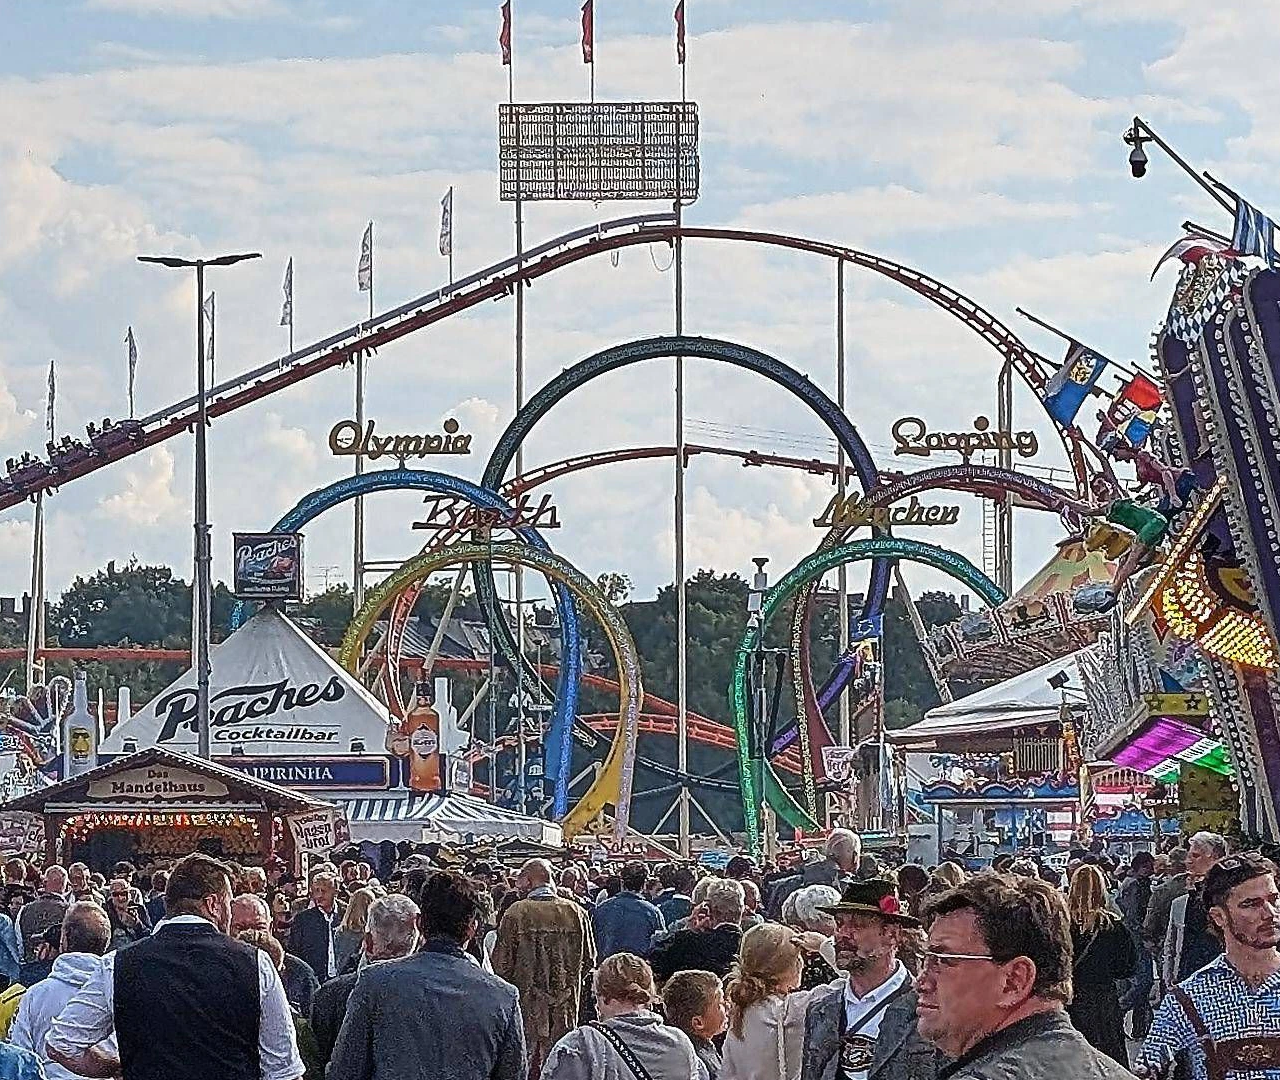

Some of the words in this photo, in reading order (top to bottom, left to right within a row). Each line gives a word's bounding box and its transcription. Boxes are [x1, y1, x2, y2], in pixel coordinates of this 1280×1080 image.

[328, 418, 473, 460] Olympia
[892, 416, 1039, 458] Looping
[214, 727, 339, 742] Cocktailbar
[147, 769, 169, 779] Das
[111, 781, 206, 794] Mandelhaus
